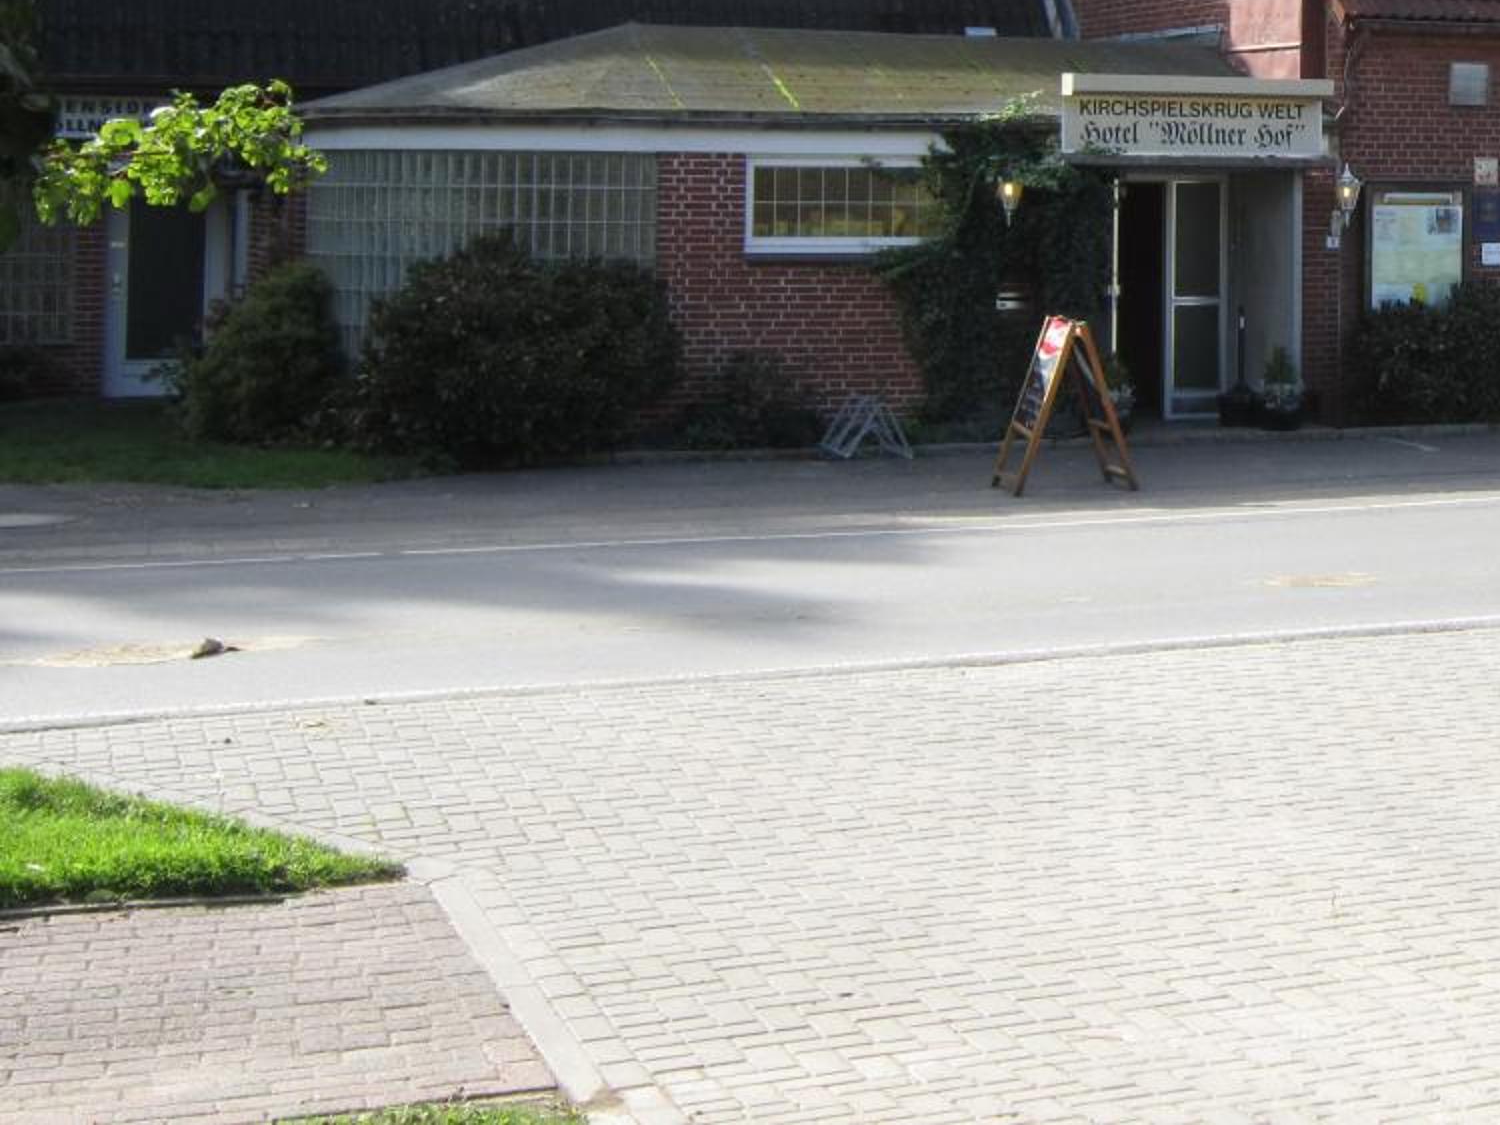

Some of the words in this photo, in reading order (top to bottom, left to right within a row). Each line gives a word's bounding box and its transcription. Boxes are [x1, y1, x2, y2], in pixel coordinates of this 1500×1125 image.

[1079, 99, 1253, 119] KIRCHSPIELSKRUG
[1258, 103, 1305, 120] WELT
[1081, 121, 1139, 145] Hotel
